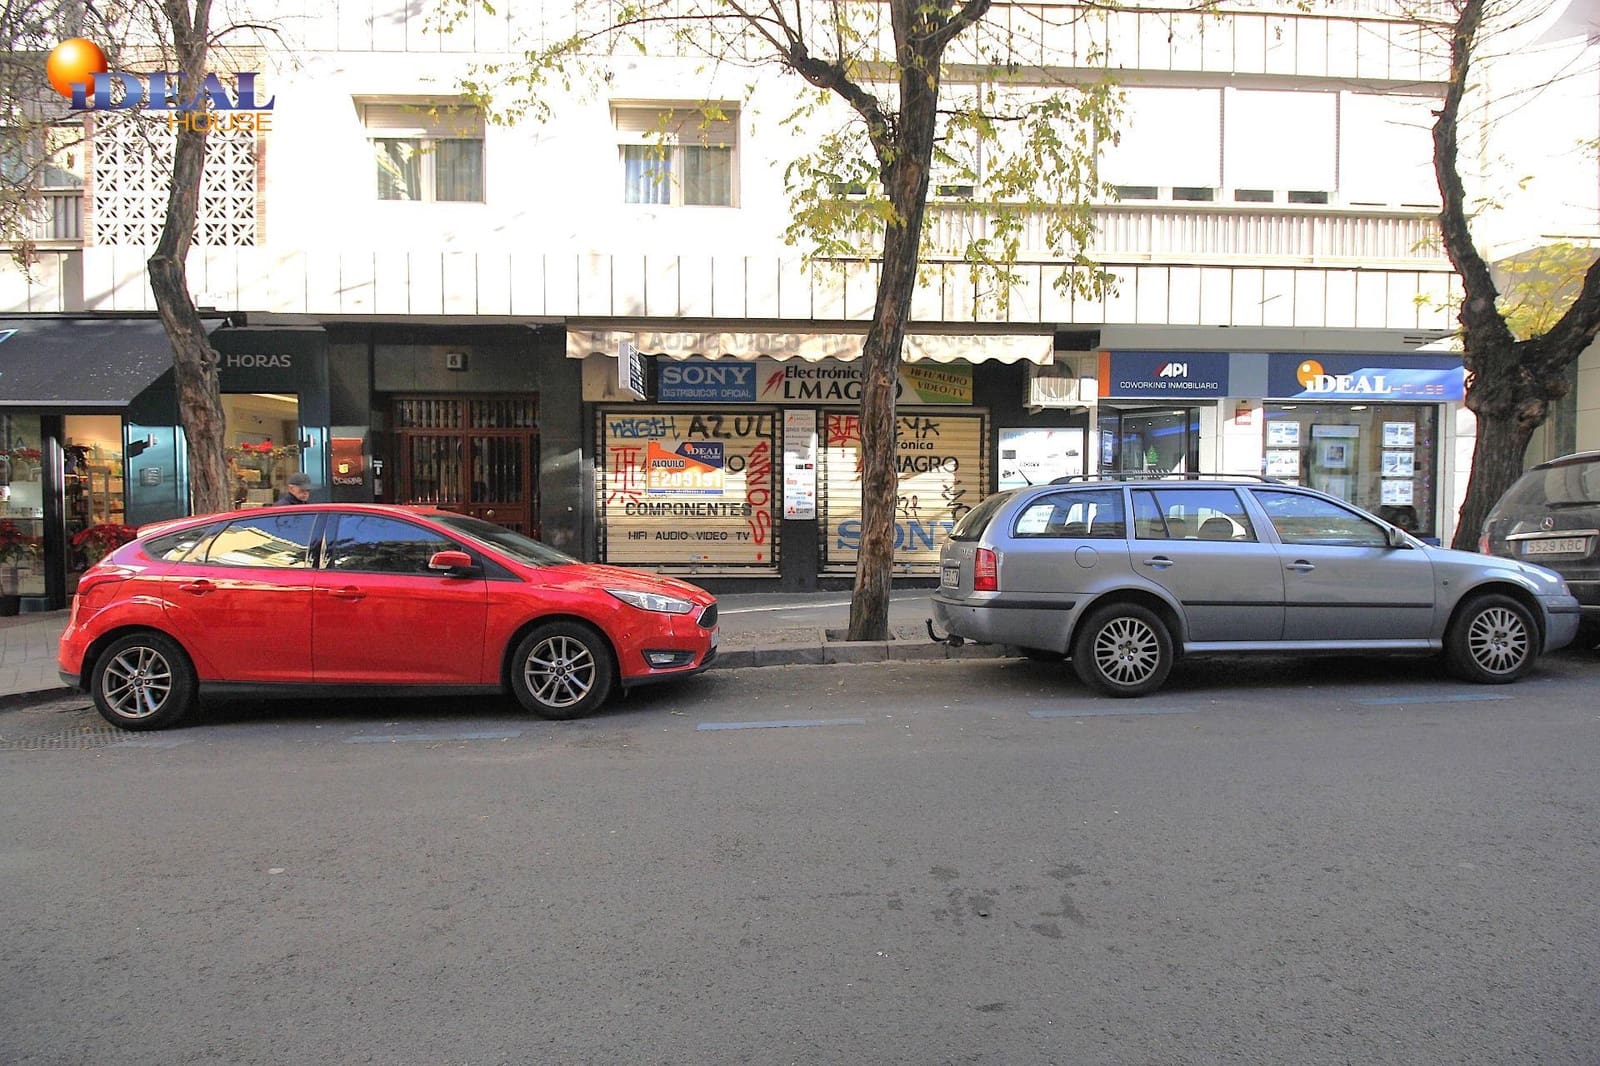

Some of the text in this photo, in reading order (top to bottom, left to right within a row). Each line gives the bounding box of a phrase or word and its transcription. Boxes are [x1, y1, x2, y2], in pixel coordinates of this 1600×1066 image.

[226, 353, 293, 368] HORAS
[662, 366, 751, 385] SONY
[784, 365, 864, 379] Electrónic
[1159, 362, 1188, 378] API
[662, 388, 718, 398] DISTRIBUIDOR
[1119, 381, 1219, 390] COWORKING INMOBILIARIO
[688, 415, 772, 440] AZUL
[625, 502, 752, 517] COMPONENTES
[628, 531, 751, 541] HIFI AUDIO VIDEO TV
